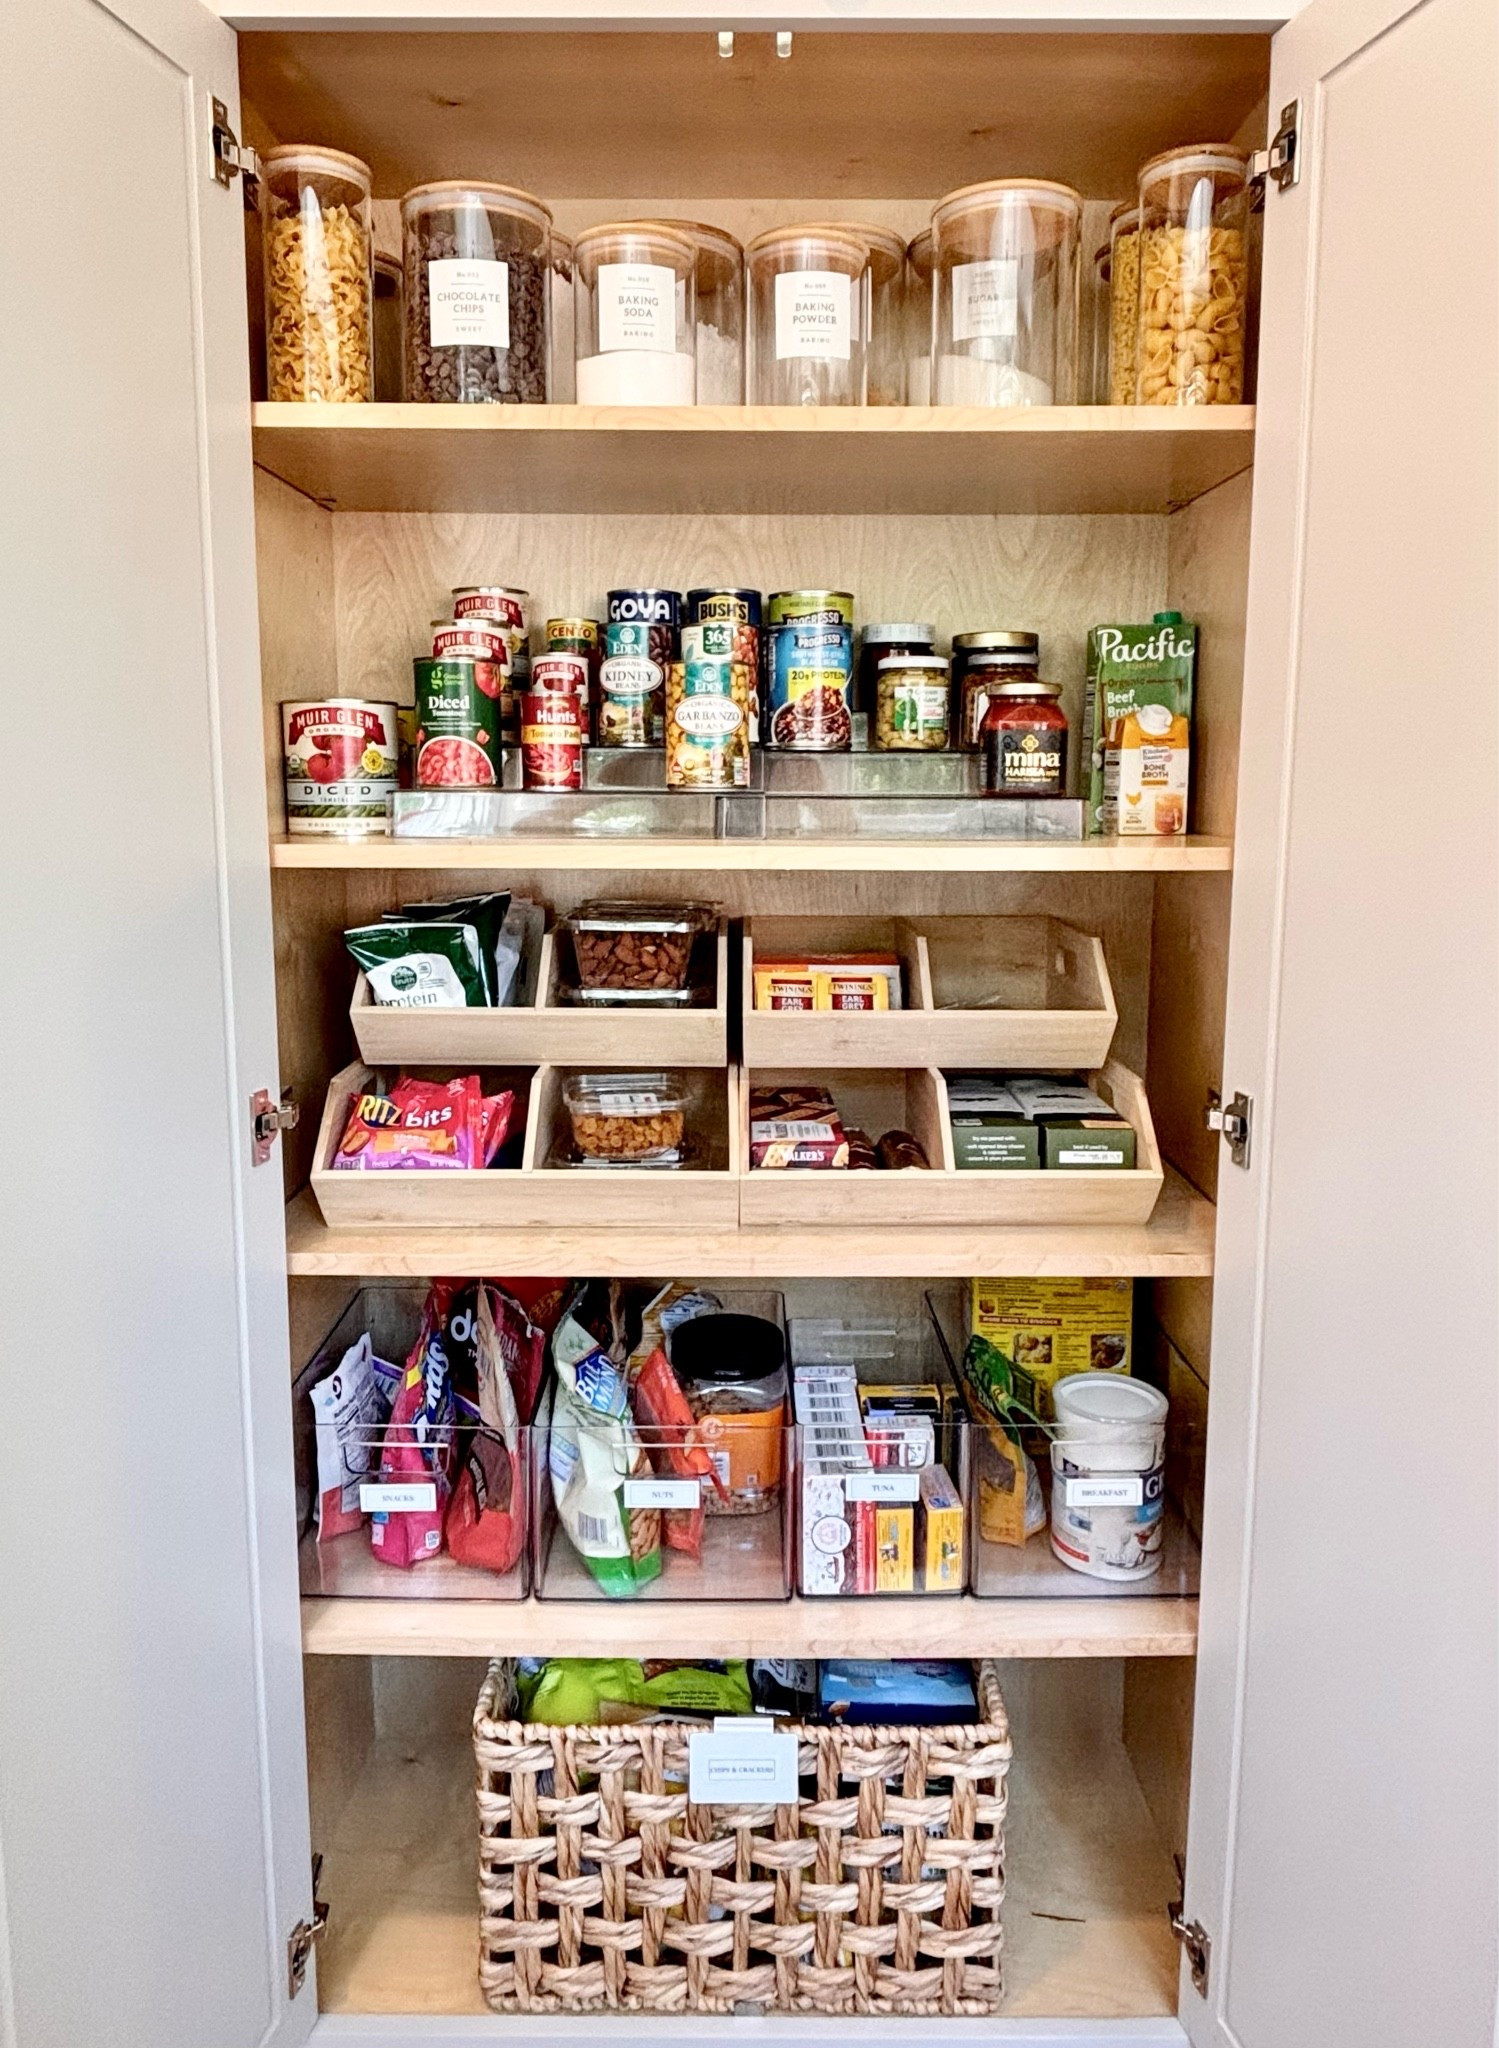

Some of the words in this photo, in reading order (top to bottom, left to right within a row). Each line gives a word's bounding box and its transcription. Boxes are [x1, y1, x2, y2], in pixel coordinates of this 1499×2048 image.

[437, 292, 501, 304] CHOCOLATE
[618, 295, 659, 307] BAKING
[453, 304, 484, 314] CHIPS
[624, 308, 653, 318] SODA
[795, 302, 835, 313] BAKING
[792, 314, 837, 325] POWDER
[623, 330, 654, 338] BAKING
[458, 599, 482, 612] MUIR
[486, 599, 515, 614] GLEN
[610, 599, 670, 621] GOYA
[700, 603, 747, 620] BUSH'S
[551, 626, 592, 638] CENTO
[705, 630, 731, 645] 365
[437, 633, 465, 650] MUIR
[469, 633, 500, 650] GLEN
[798, 634, 841, 648] PROGRESSO
[1097, 628, 1195, 663] Pacific
[613, 643, 643, 655] EDEN
[536, 664, 556, 675] MUIR
[559, 664, 580, 676] GLEN
[792, 671, 809, 680] 20g
[605, 671, 653, 682] KIDNEY
[695, 680, 724, 692] EDEN
[428, 694, 470, 709] Diced
[1107, 689, 1135, 704] Beef
[296, 710, 330, 728] MUIR
[336, 710, 374, 729] GLEN
[678, 711, 739, 721] GARBANZO
[1004, 752, 1061, 767] mina
[304, 786, 371, 795] DICED
[772, 985, 814, 993] TWININGS
[833, 983, 873, 992] TWININGS
[356, 1094, 404, 1127] RITZ
[405, 1106, 452, 1128] bits
[782, 1149, 825, 1161] WALKER'S
[575, 1360, 601, 1404] BLUE
[872, 1484, 895, 1492] TUNA
[1082, 1489, 1128, 1497] BREAKFAST
[652, 1491, 674, 1499] NUTS
